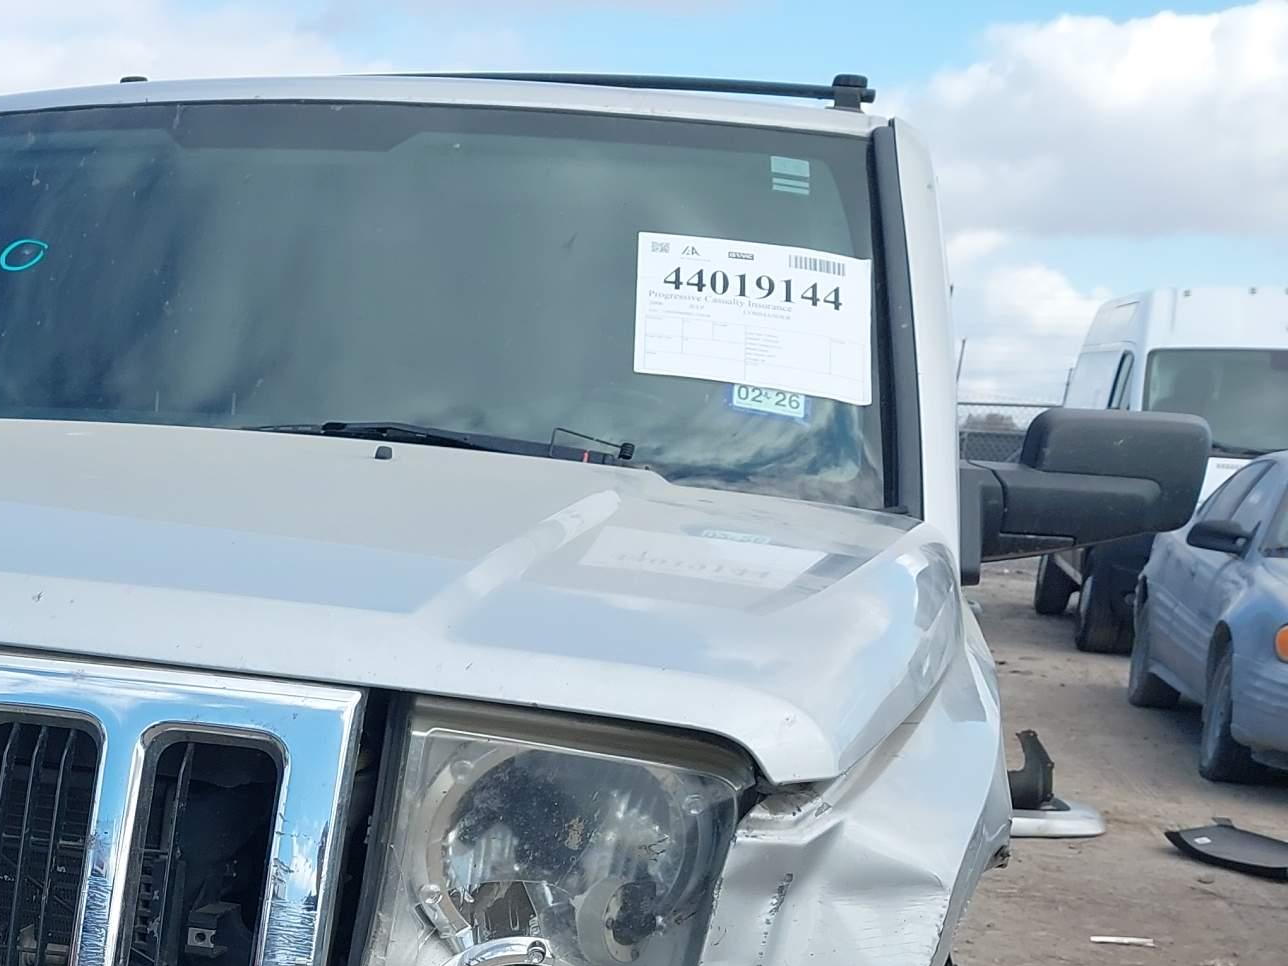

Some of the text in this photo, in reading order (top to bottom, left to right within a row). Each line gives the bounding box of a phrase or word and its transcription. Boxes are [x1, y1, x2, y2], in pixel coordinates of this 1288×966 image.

[648, 288, 703, 303] Progressive
[704, 295, 746, 309] Casualty
[747, 298, 793, 313] Insurance
[663, 266, 844, 312] 44019144
[737, 385, 801, 410] 02 26
